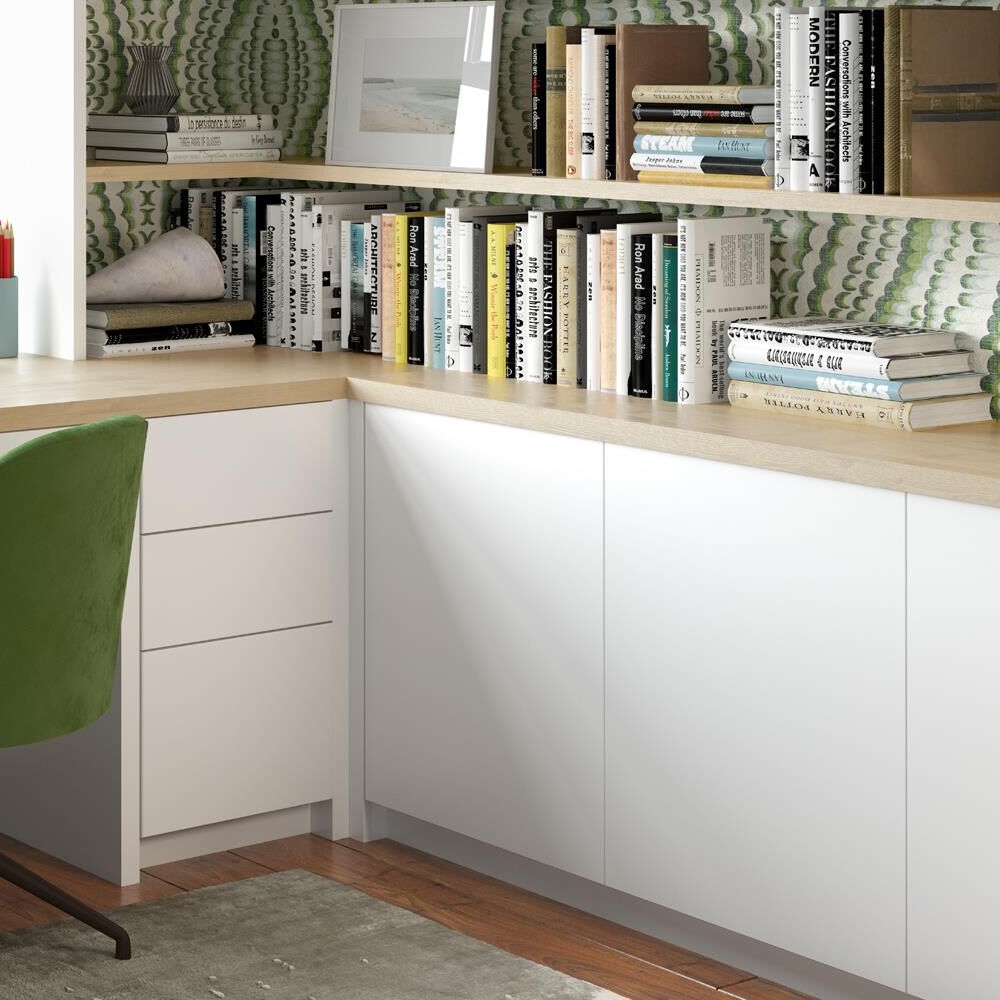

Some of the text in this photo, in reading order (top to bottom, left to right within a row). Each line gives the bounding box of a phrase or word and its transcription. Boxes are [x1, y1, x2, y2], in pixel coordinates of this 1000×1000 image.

[809, 16, 820, 87] MODERN
[532, 96, 540, 110] than
[825, 12, 836, 188] THE FASHION BOOK
[842, 39, 852, 162] Conversations with Architects
[532, 110, 540, 130] others
[641, 134, 696, 152] STEAM
[810, 163, 820, 178] A
[300, 248, 309, 262] arts
[528, 257, 540, 273] arts
[268, 226, 276, 322] Conversations with Architects
[408, 225, 418, 332] Ron Arad No Discipline
[300, 273, 310, 314] architecture
[633, 243, 646, 360] Ron Arad No Discipline
[528, 287, 541, 338] architecture
[544, 241, 553, 380] THE FASHION BOOK
[434, 317, 442, 353] IAN HUNT
[711, 339, 718, 347] by
[766, 348, 814, 368] architecture
[826, 355, 844, 371] arts
[744, 370, 889, 400] STEAM IAN HUNT
[763, 398, 866, 420] HARRY POTTER
